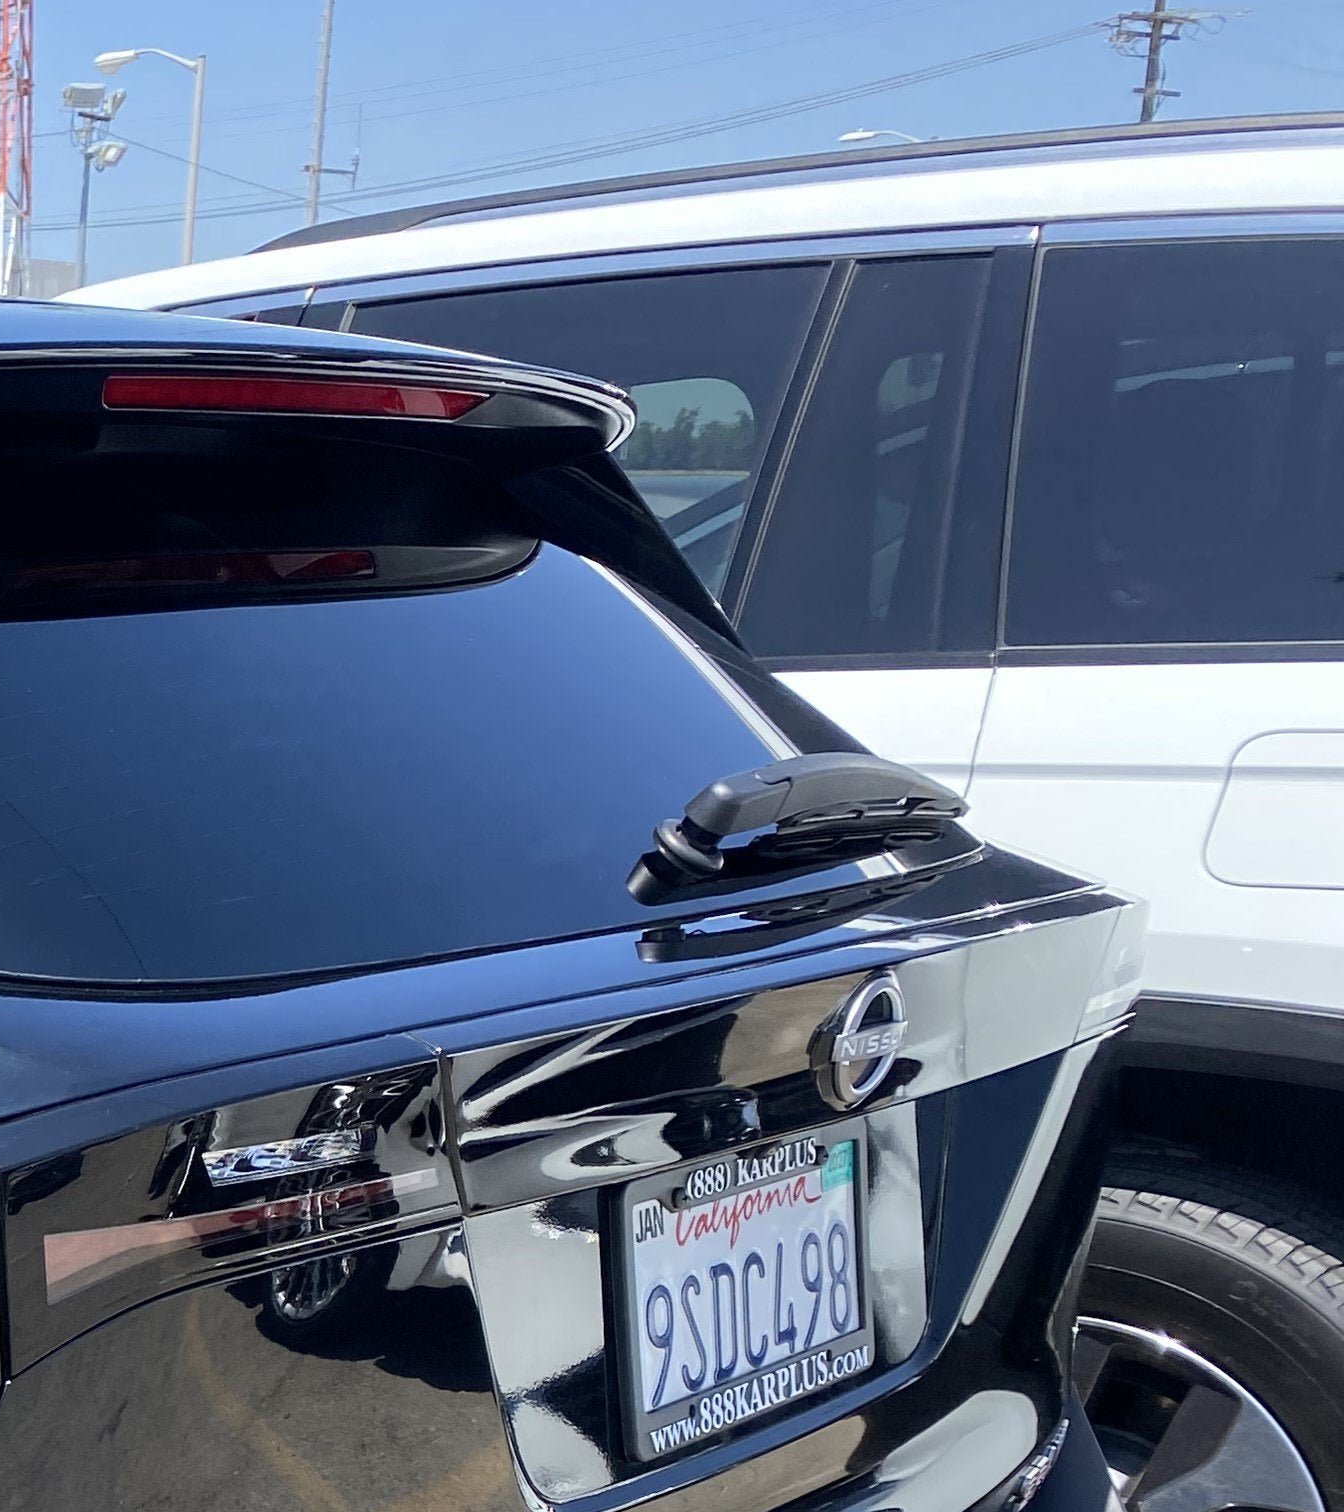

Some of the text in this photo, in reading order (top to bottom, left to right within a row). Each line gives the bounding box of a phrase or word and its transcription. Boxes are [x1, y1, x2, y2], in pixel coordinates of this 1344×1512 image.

[840, 1030, 902, 1058] NISS
[685, 1137, 818, 1203] (888) KARPLUS
[635, 1204, 665, 1244] JAN
[675, 1175, 823, 1250] California
[644, 1220, 853, 1408] 9SDC498
